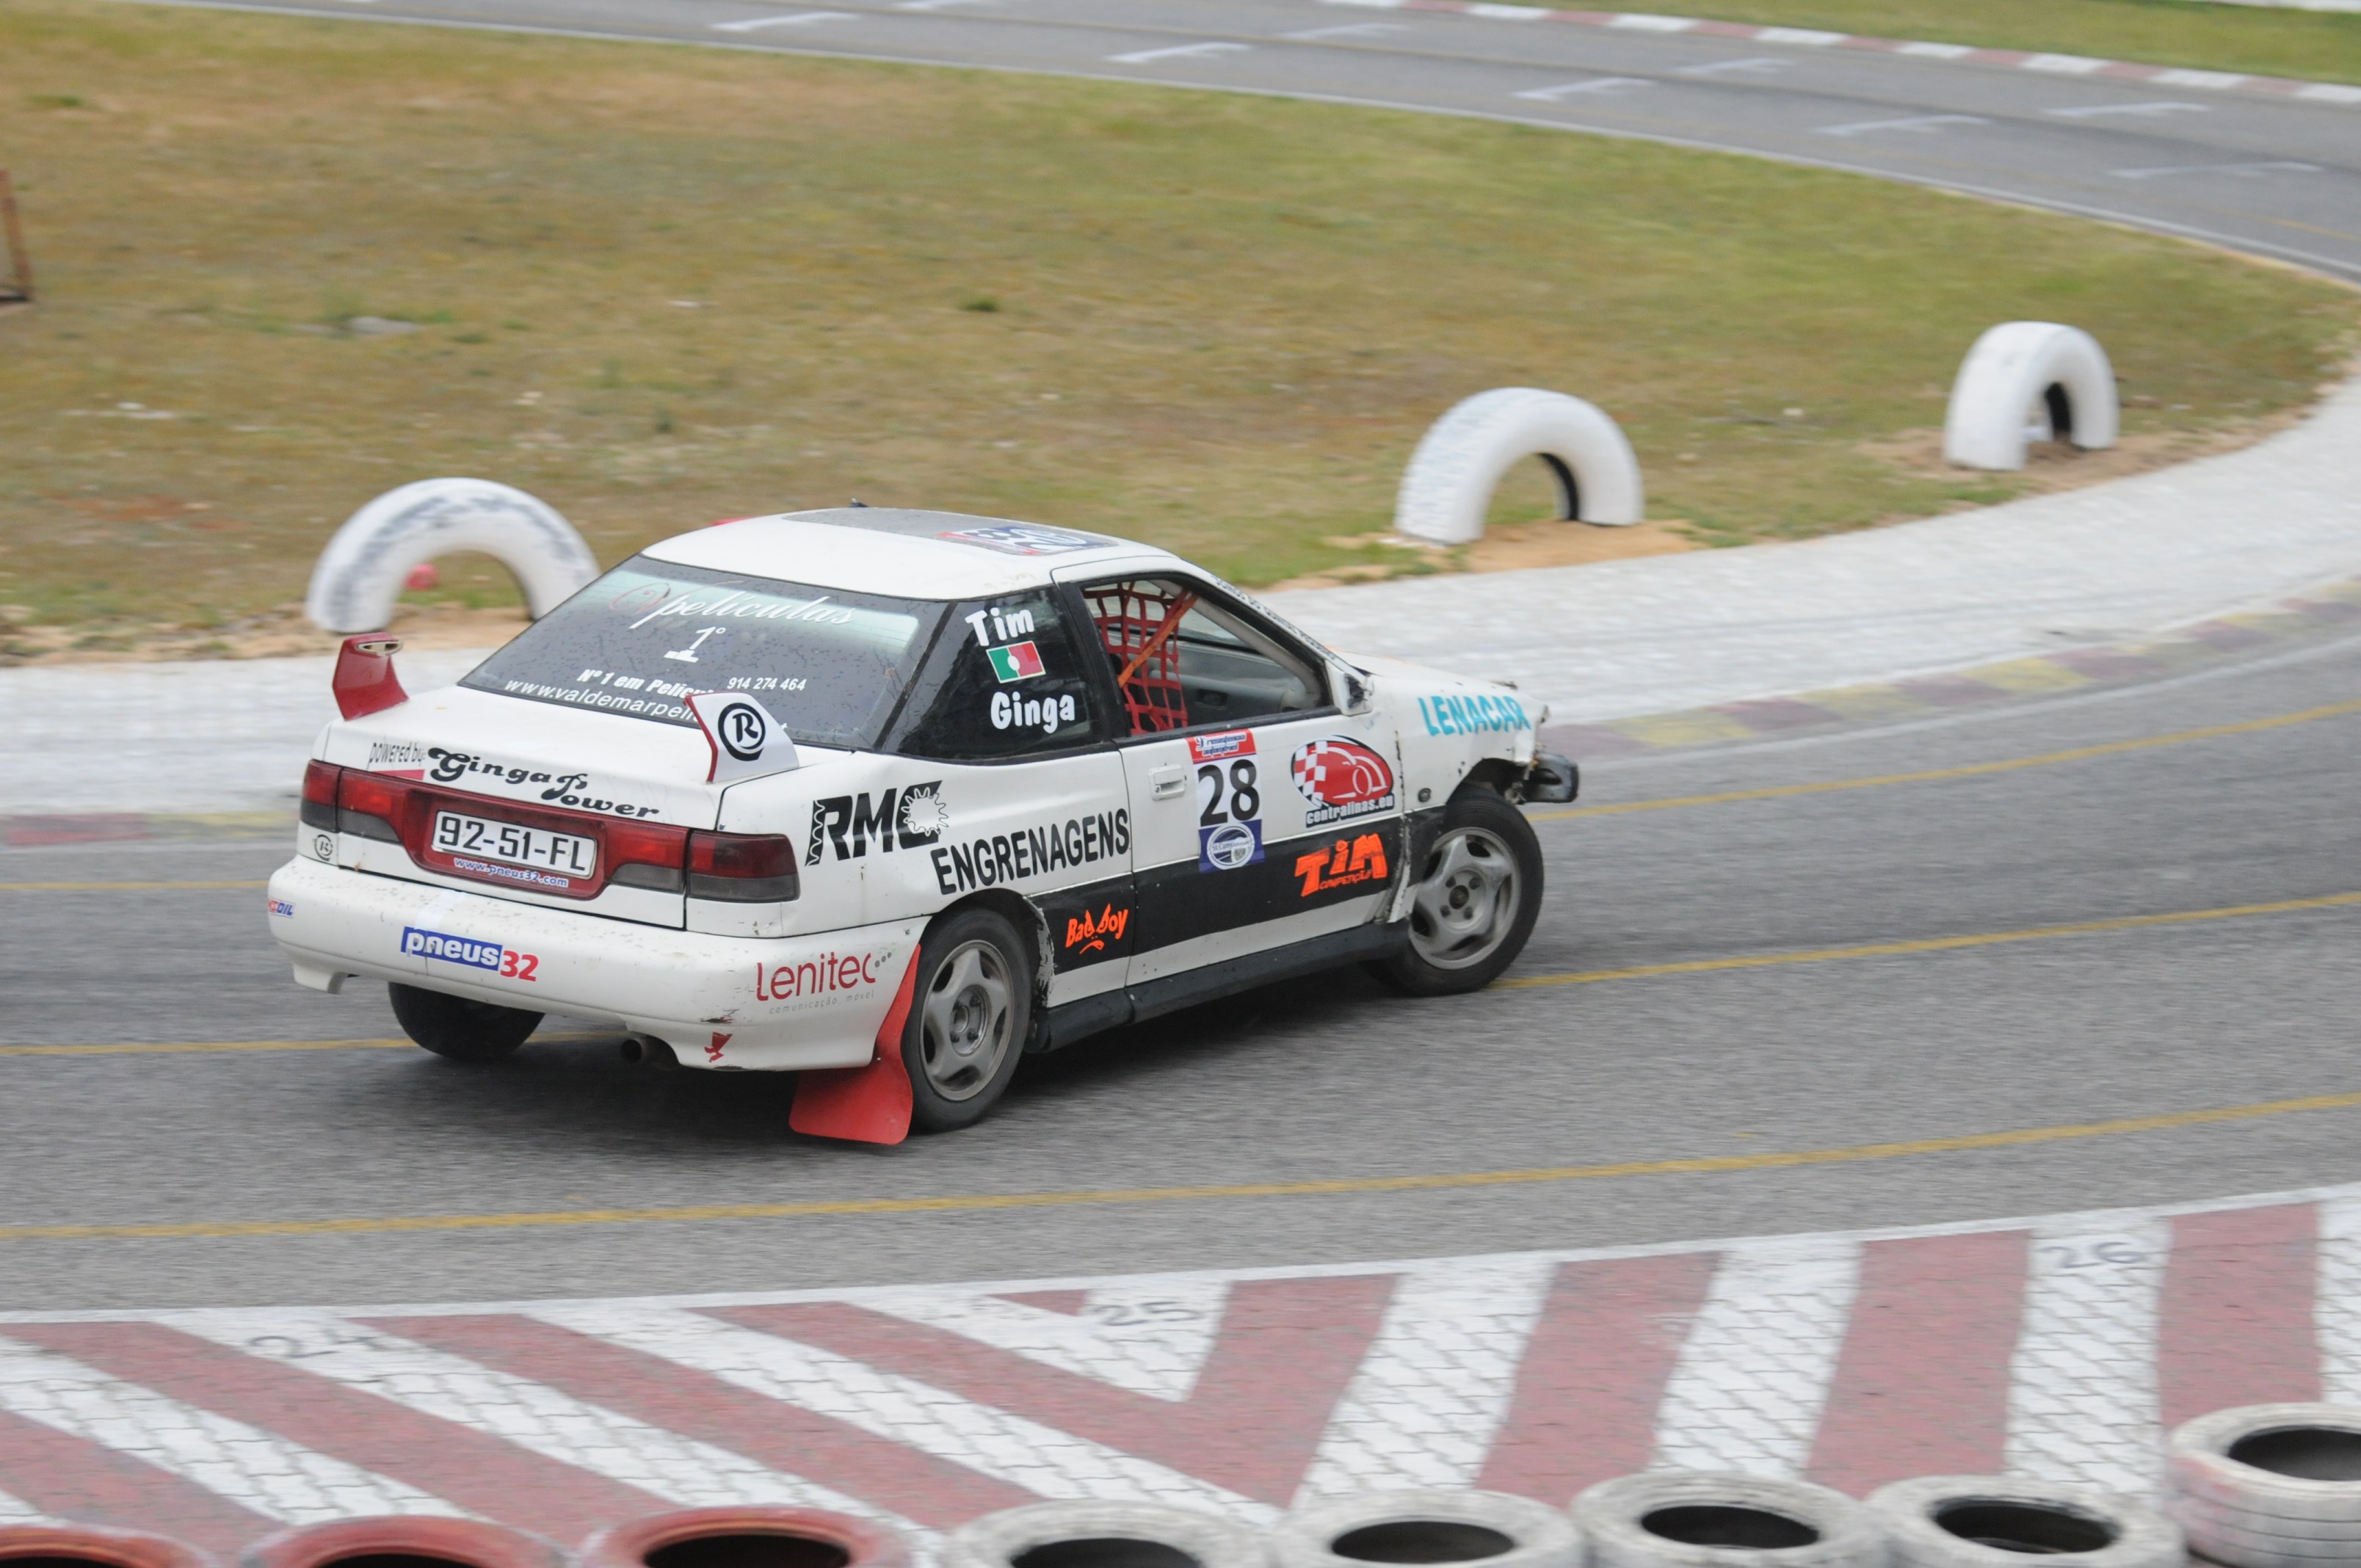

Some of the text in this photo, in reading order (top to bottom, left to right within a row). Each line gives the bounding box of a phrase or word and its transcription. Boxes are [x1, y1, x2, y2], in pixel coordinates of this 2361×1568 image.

[965, 608, 1034, 646] Tim
[603, 673, 614, 686] 1
[614, 677, 645, 690] em
[727, 677, 806, 691] 914 274 464
[991, 692, 1075, 733] Ginga
[1418, 696, 1531, 736] LENACAR
[428, 747, 659, 818] Ginga Power
[1197, 759, 1260, 827] 28
[805, 780, 949, 866] RMC
[1306, 795, 1394, 827] centralinas.eu
[440, 816, 586, 872] 92-51-FL
[931, 808, 1129, 896] ENGRENAGENS
[454, 857, 569, 887] www.pneus32.com
[1065, 910, 1095, 948] Bad
